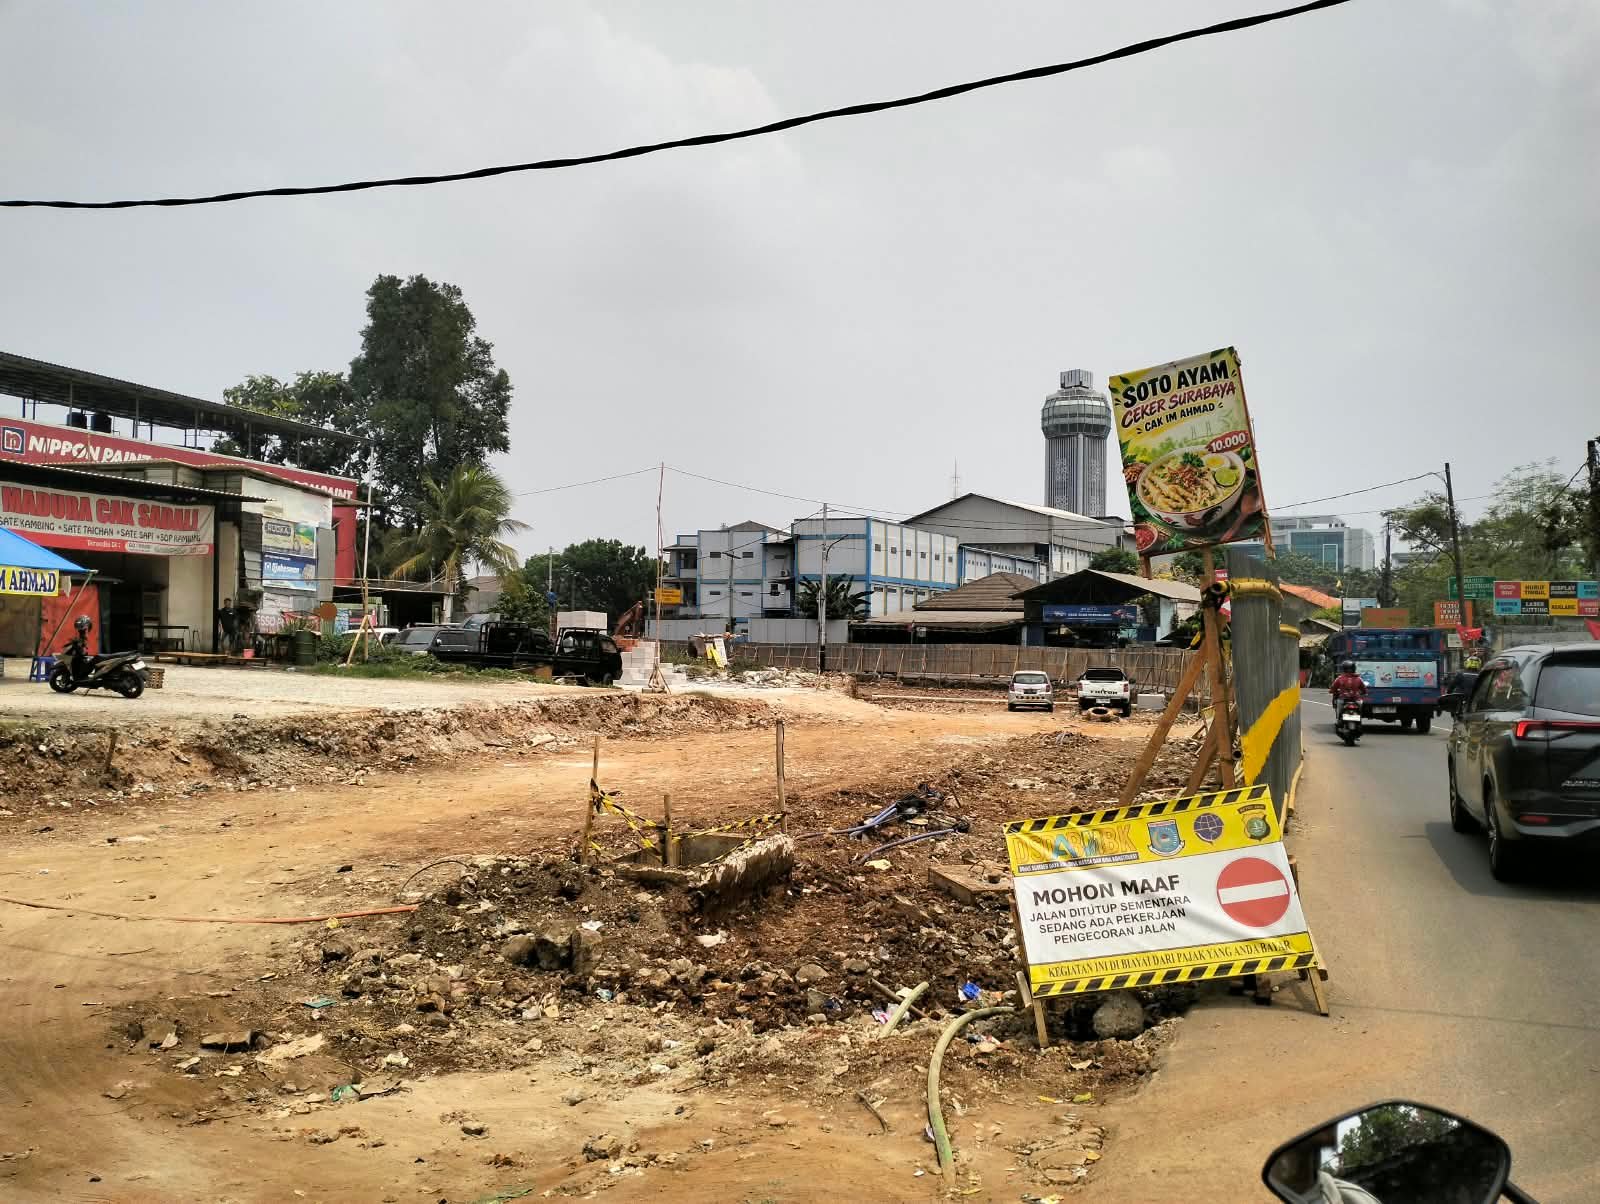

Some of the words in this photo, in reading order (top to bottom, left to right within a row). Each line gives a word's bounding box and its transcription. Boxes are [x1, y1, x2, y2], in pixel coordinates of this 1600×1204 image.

[1122, 374, 1172, 408] SOTO
[1177, 360, 1229, 389] AYAM
[1121, 399, 1166, 428] CEKER
[1168, 381, 1236, 410] SURABAYA
[1145, 419, 1163, 432] CAK
[1166, 411, 1177, 423] IM
[1180, 402, 1215, 419] AHMAD
[28, 435, 99, 461] NIPPON
[1211, 432, 1246, 453] 10.000
[1, 486, 93, 522] MADURA
[0, 517, 19, 527] SATE
[20, 520, 55, 531] KAMBING
[63, 523, 81, 534] SATE
[83, 525, 114, 537] TAICHAN
[120, 528, 137, 539] SATE
[139, 530, 154, 540] SAPI
[160, 533, 172, 542] SOP
[9, 569, 57, 592] AHMAD
[1033, 883, 1115, 906] MOHON
[1120, 874, 1180, 896] MAAF
[1030, 909, 1067, 922] JALAN
[1069, 903, 1117, 918] DITUTUP
[1120, 895, 1191, 912] SEMENTARA
[1039, 919, 1087, 934] SEDANG
[1090, 917, 1114, 928] ADA
[1116, 907, 1186, 925] PEKERJAAN
[1054, 927, 1135, 945] PENGECORAN
[1138, 922, 1176, 935] JALAN
[1048, 961, 1094, 978] KEGIATAN
[1094, 960, 1109, 972] INI
[1109, 959, 1120, 970] DI
[1121, 956, 1151, 969] BIAYAI
[1152, 953, 1176, 967] DARI
[1177, 950, 1205, 964] PAJAK
[1206, 945, 1233, 960] YANG
[1234, 943, 1259, 957] ANDA
